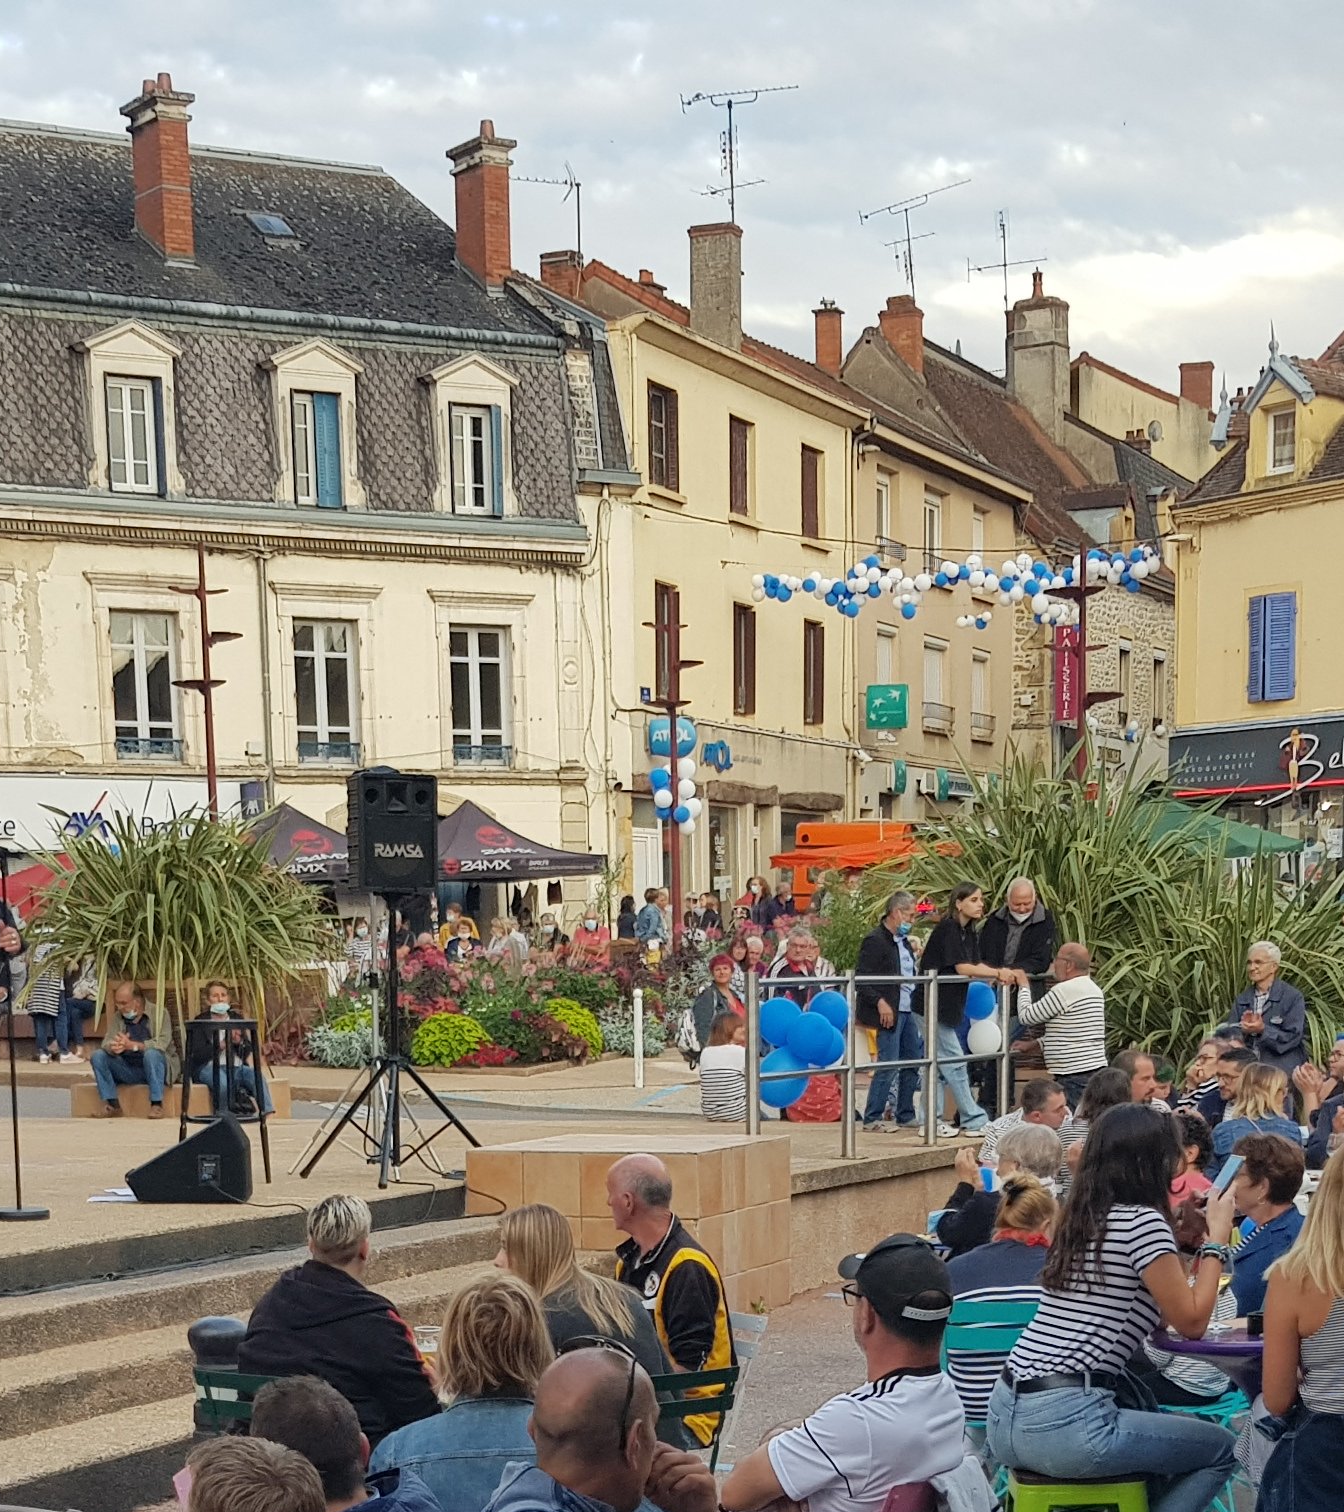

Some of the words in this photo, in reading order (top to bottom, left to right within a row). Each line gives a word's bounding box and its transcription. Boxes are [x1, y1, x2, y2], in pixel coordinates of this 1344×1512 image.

[374, 843, 424, 859] RAMSA
[282, 862, 328, 875] 4MX
[460, 859, 512, 872] 24MX
